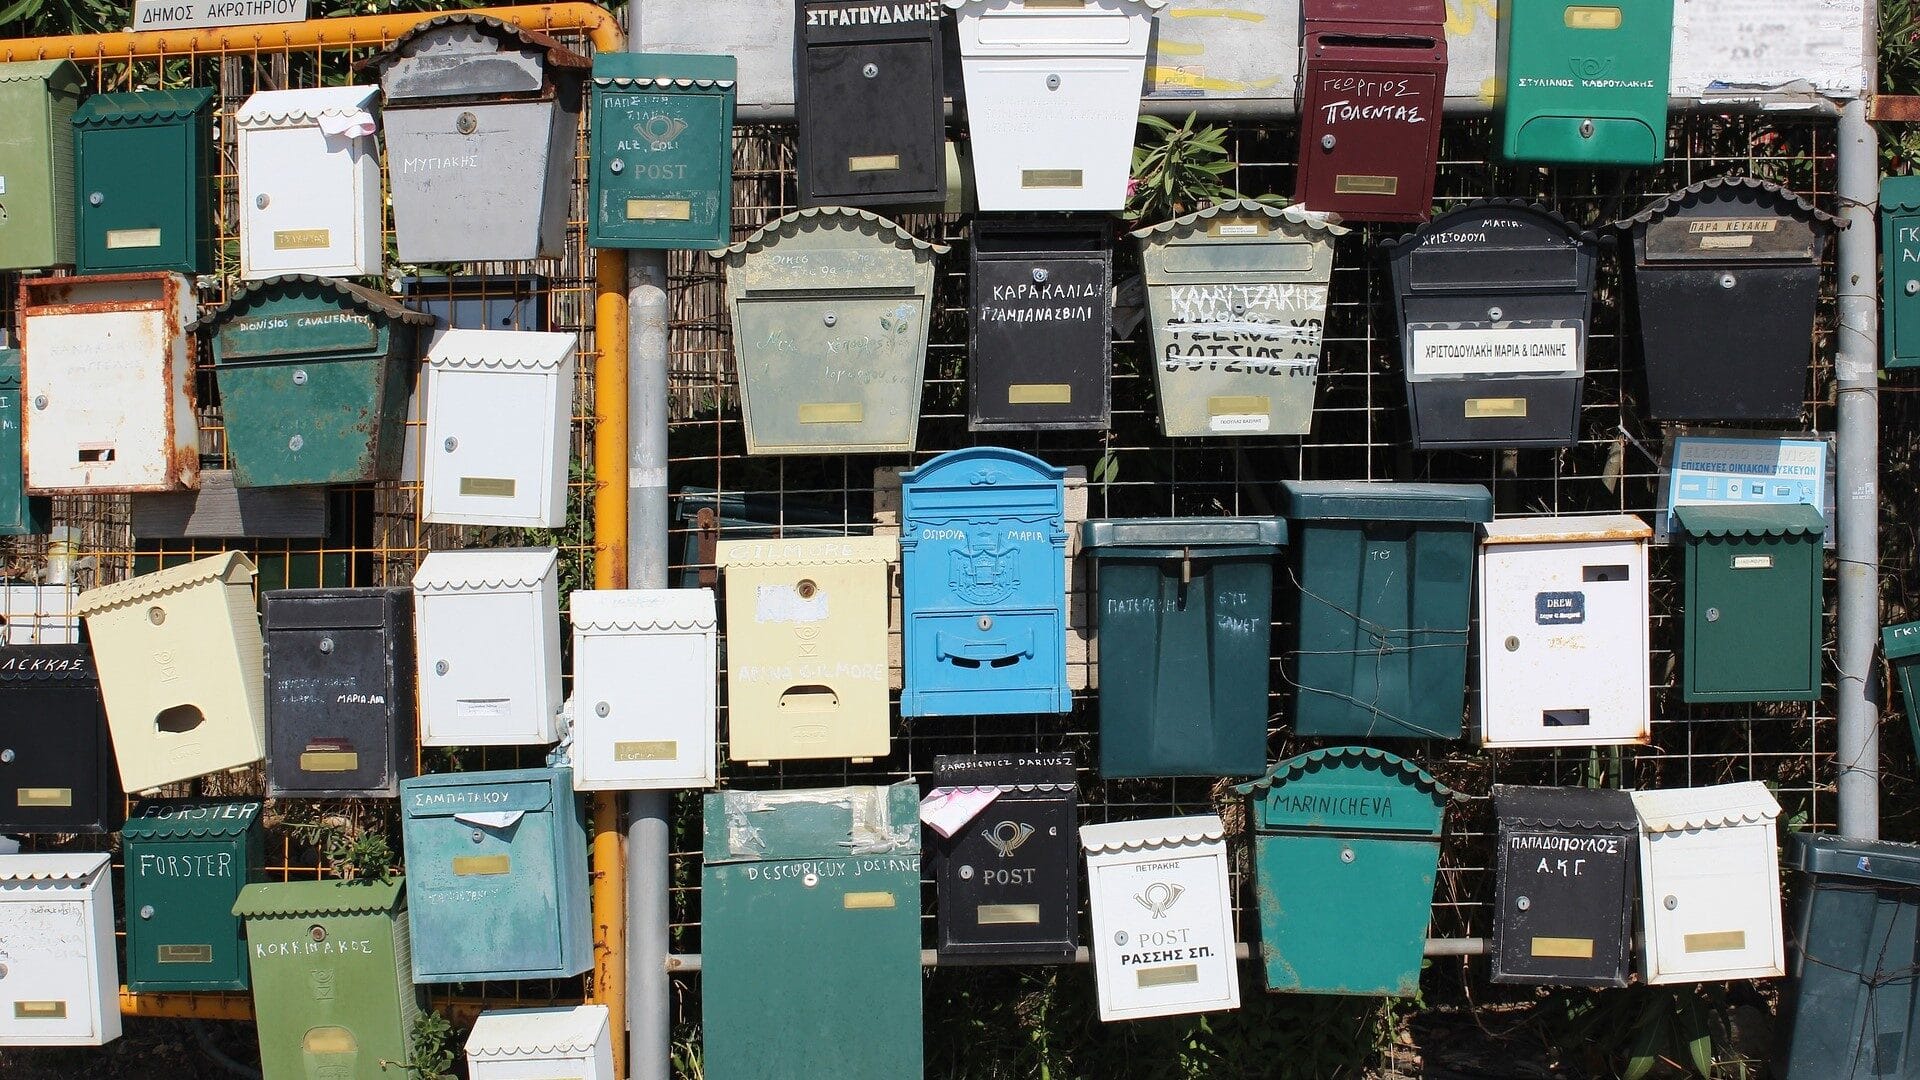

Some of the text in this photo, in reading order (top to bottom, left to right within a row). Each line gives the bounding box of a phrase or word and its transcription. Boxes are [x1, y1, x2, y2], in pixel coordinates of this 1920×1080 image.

[143, 0, 297, 23] ΔΗΜΟΣ ΑΚΡΩΤΗΡΙΟΥ
[806, 1, 940, 26] ΣΤΡΑΤΟΥΔΑΚΗΣ
[1518, 78, 1654, 88] ΣΤΥΛΙΑΝΟΣ ΚΑΒΡΟΥΛΑΚΗΣ
[1320, 100, 1427, 124] ΠΟΛΕΝΤΑΣ
[404, 155, 478, 174] ΜΥΓΙΑΚΗΣ
[634, 164, 688, 180] POST
[240, 318, 289, 332] DIONISIOS
[1425, 343, 1567, 358] ΧΡΙΣΤΟΔΟΥΛΑΚΗ ΜΑΡΙΑ & ΙΩΑΝΝΗΣ
[1771, 464, 1817, 476] ΣΥΣΚΕΥΩΝ
[1546, 598, 1573, 608] DREW
[1018, 757, 1073, 767] DARIUSZ
[415, 792, 509, 807] ΣΑΜΠΑΤΑΚΟΥ
[1272, 794, 1393, 818] MARINICHEVA
[141, 802, 259, 820] FORSTER
[1511, 836, 1618, 854] ΠΑΠΑΔΟΠΟΥΛΟΣ
[140, 852, 231, 877] FORSTER
[854, 858, 919, 877] JOSIANE
[1135, 862, 1181, 873] ΠΕΤΡΑΚΗΣ
[983, 868, 1036, 886] POST
[1139, 928, 1190, 948] POST
[1121, 947, 1215, 966] ΡΑΣΣΗΣ ΣΠ.
